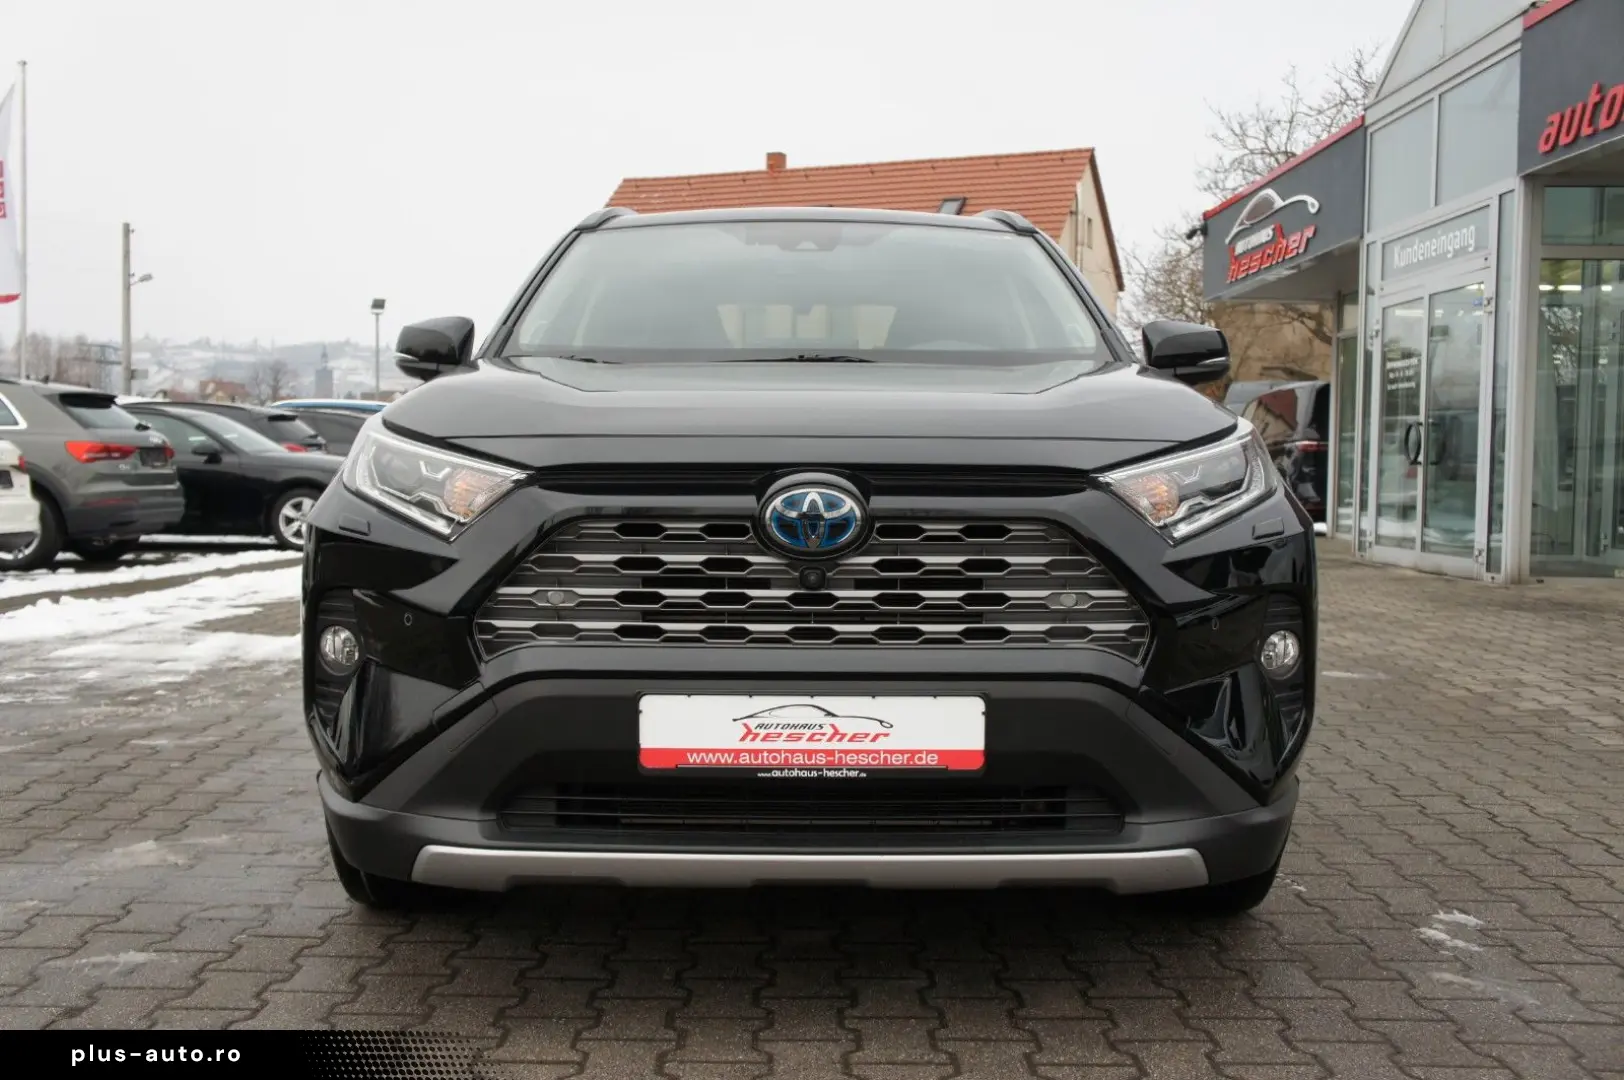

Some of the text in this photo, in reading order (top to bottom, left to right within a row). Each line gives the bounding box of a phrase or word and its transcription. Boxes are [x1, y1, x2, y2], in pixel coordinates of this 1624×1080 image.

[1538, 81, 1624, 154] auto
[1226, 223, 1316, 284] hescher
[1393, 225, 1476, 269] Kundeneingang
[738, 722, 890, 743] hescher
[754, 722, 825, 731] AUTOHAUS
[688, 750, 938, 765] www.autohaus-hescher.de
[757, 768, 867, 778] www.autohaus-hescher.de
